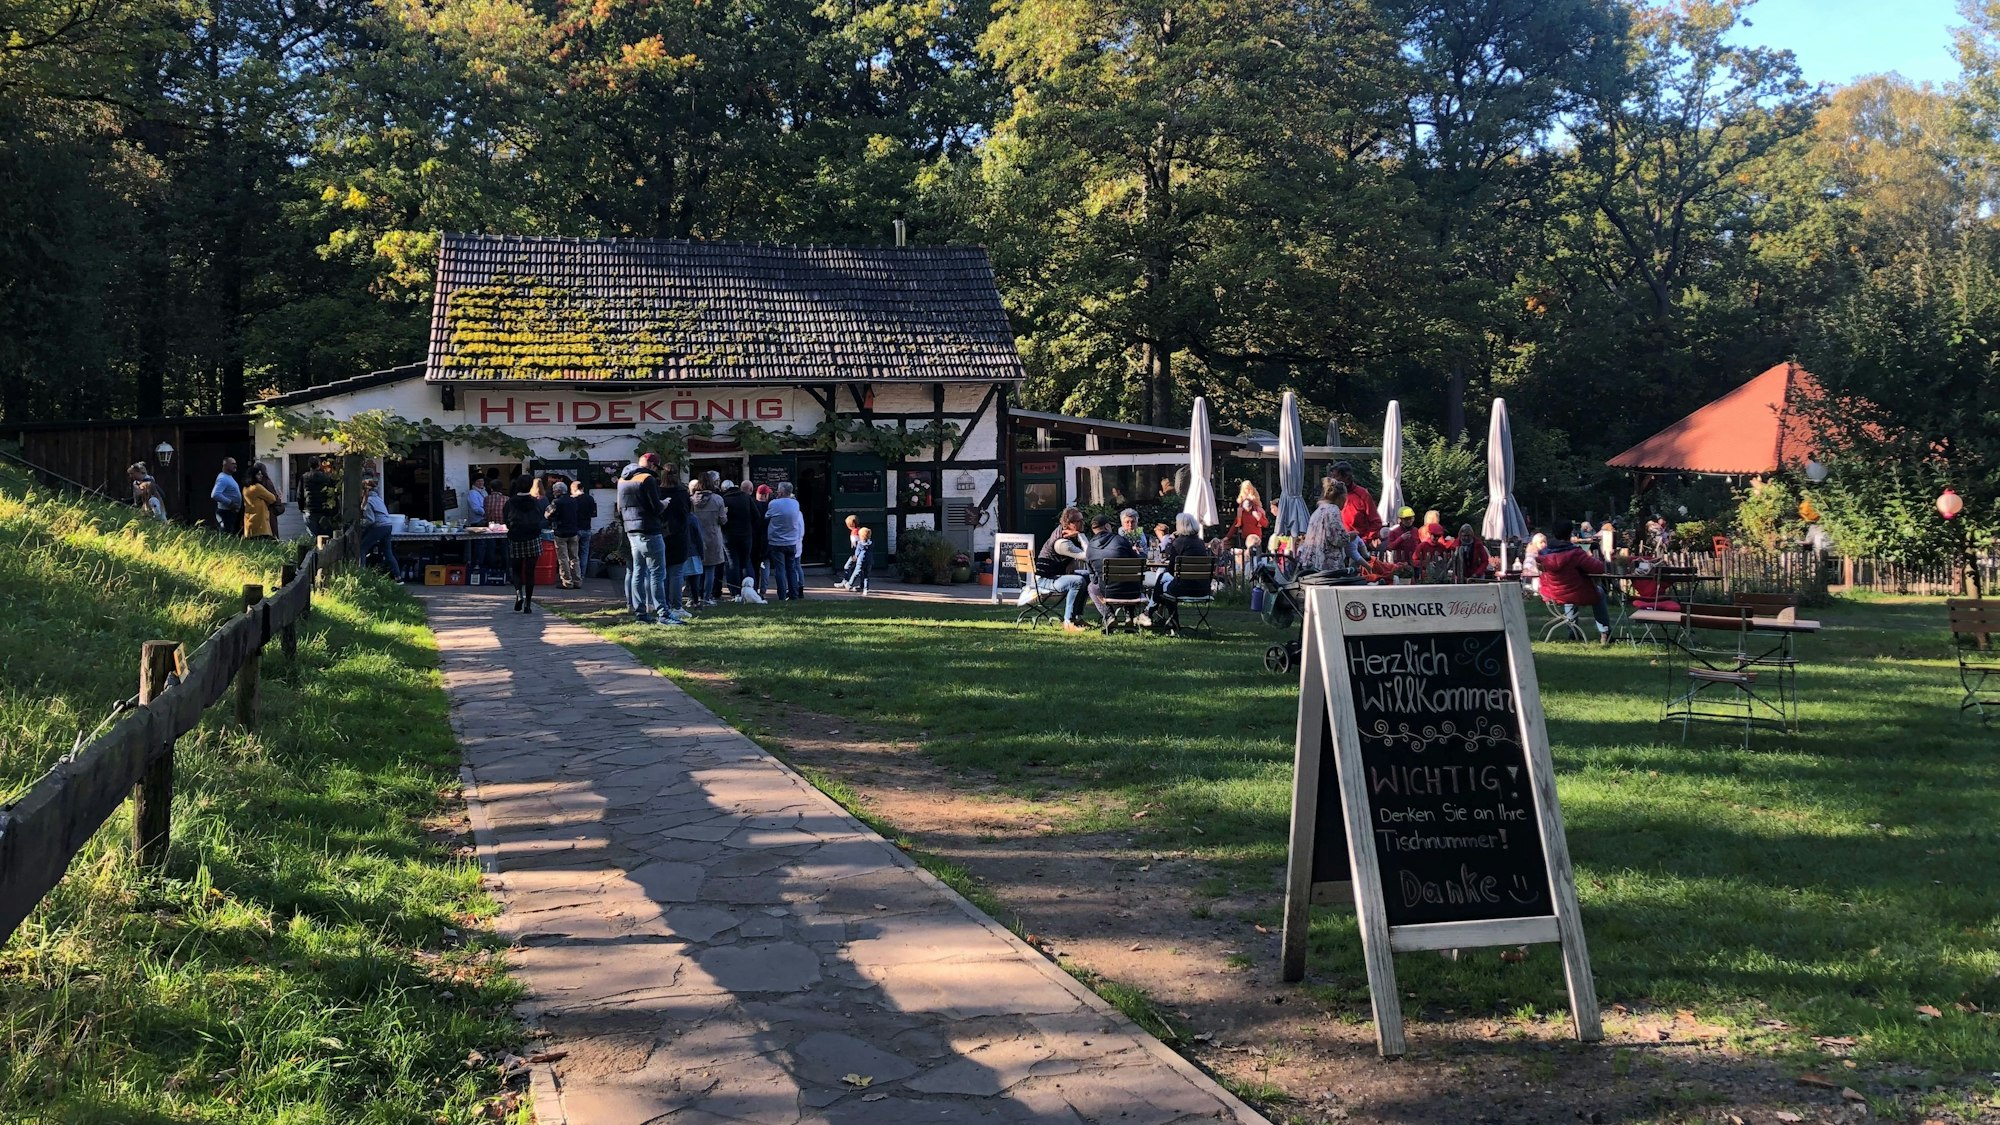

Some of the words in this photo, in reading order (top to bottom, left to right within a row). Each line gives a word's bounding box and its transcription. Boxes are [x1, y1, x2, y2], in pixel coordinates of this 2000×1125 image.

[480, 391, 783, 423] HEIDEKÖNIG
[1372, 602, 1446, 618] ERDINGER
[1448, 600, 1498, 619] Weißbier
[1348, 638, 1449, 676] Herzlich
[1442, 803, 1467, 821] Sie
[1474, 808, 1494, 821] an
[1498, 803, 1527, 821] Ihre
[1376, 828, 1509, 852] Tischnummer!
[1400, 863, 1500, 908] Danke
